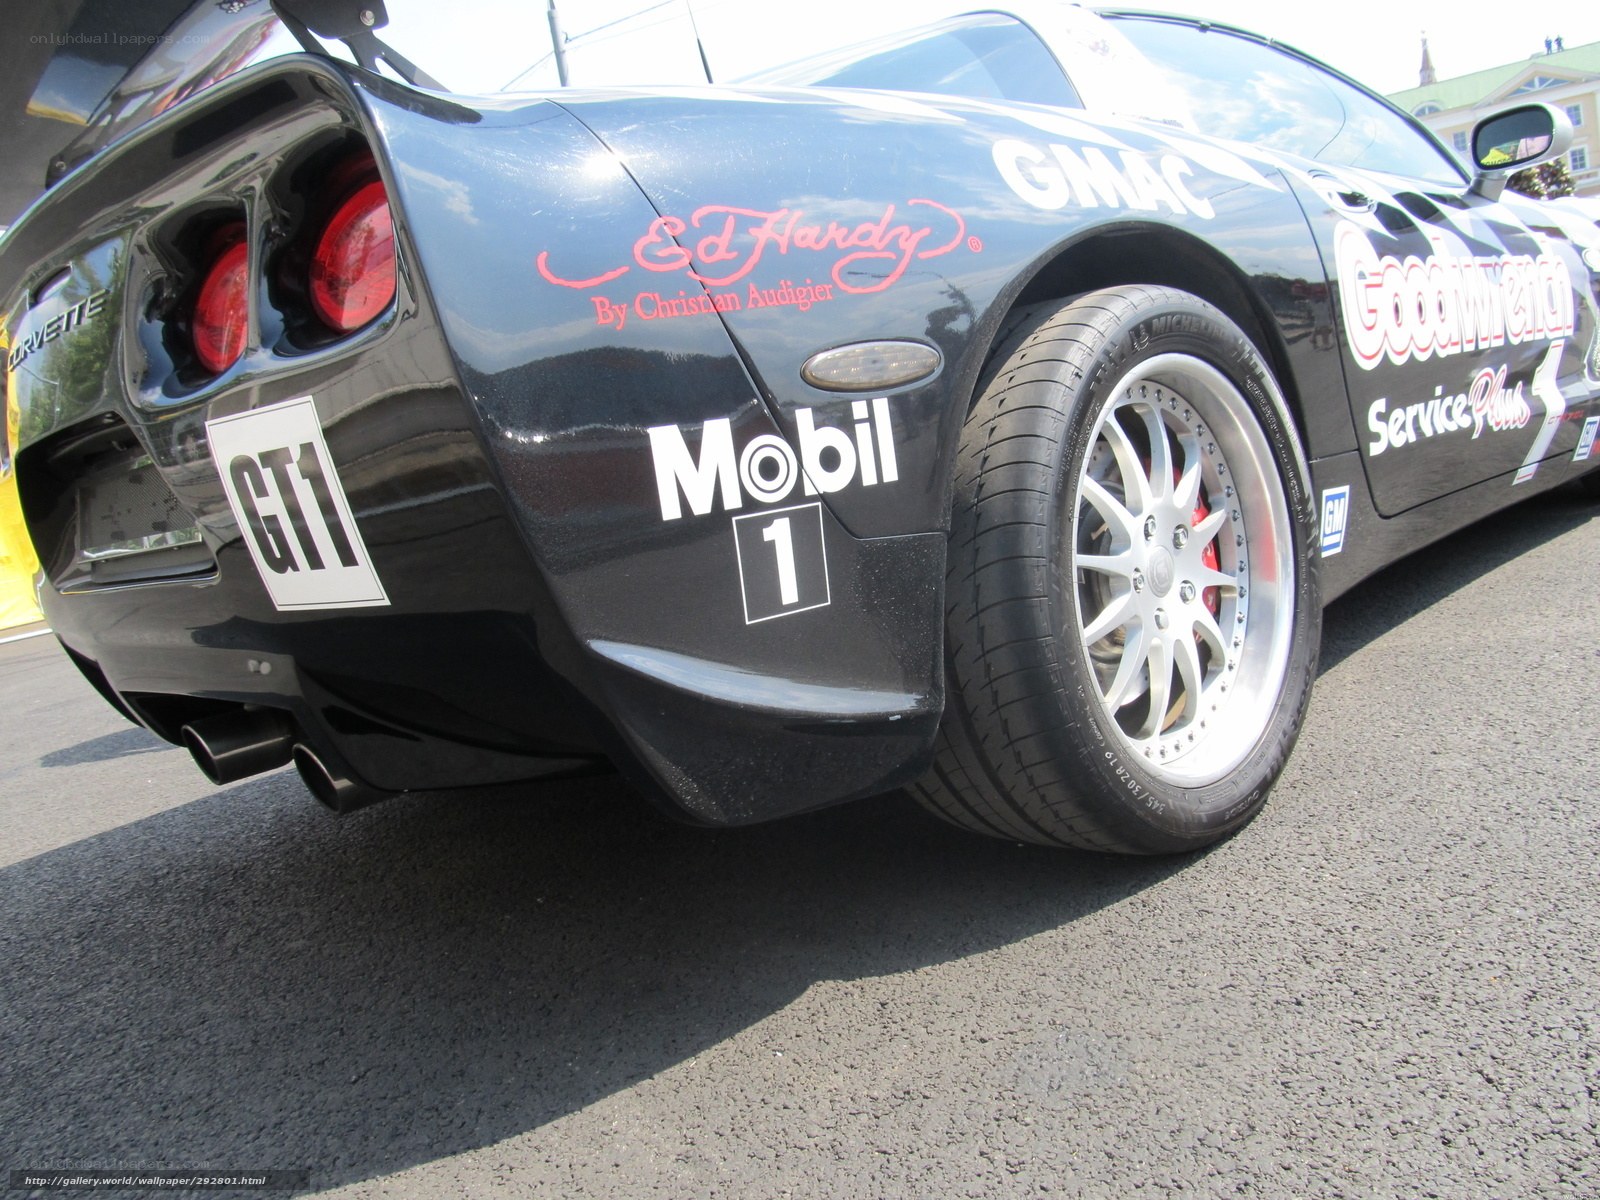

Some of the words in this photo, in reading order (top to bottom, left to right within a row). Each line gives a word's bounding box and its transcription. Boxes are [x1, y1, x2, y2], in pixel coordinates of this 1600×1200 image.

[991, 139, 1216, 220] GMAC
[690, 200, 932, 294] Hardy
[7, 288, 110, 372] CORVETTE
[591, 296, 628, 331] By
[634, 288, 741, 321] Christian
[746, 278, 833, 312] Audigier
[647, 397, 899, 521] Mobil
[229, 441, 360, 574] GT1
[1324, 497, 1345, 535] GM
[763, 517, 799, 606] 1
